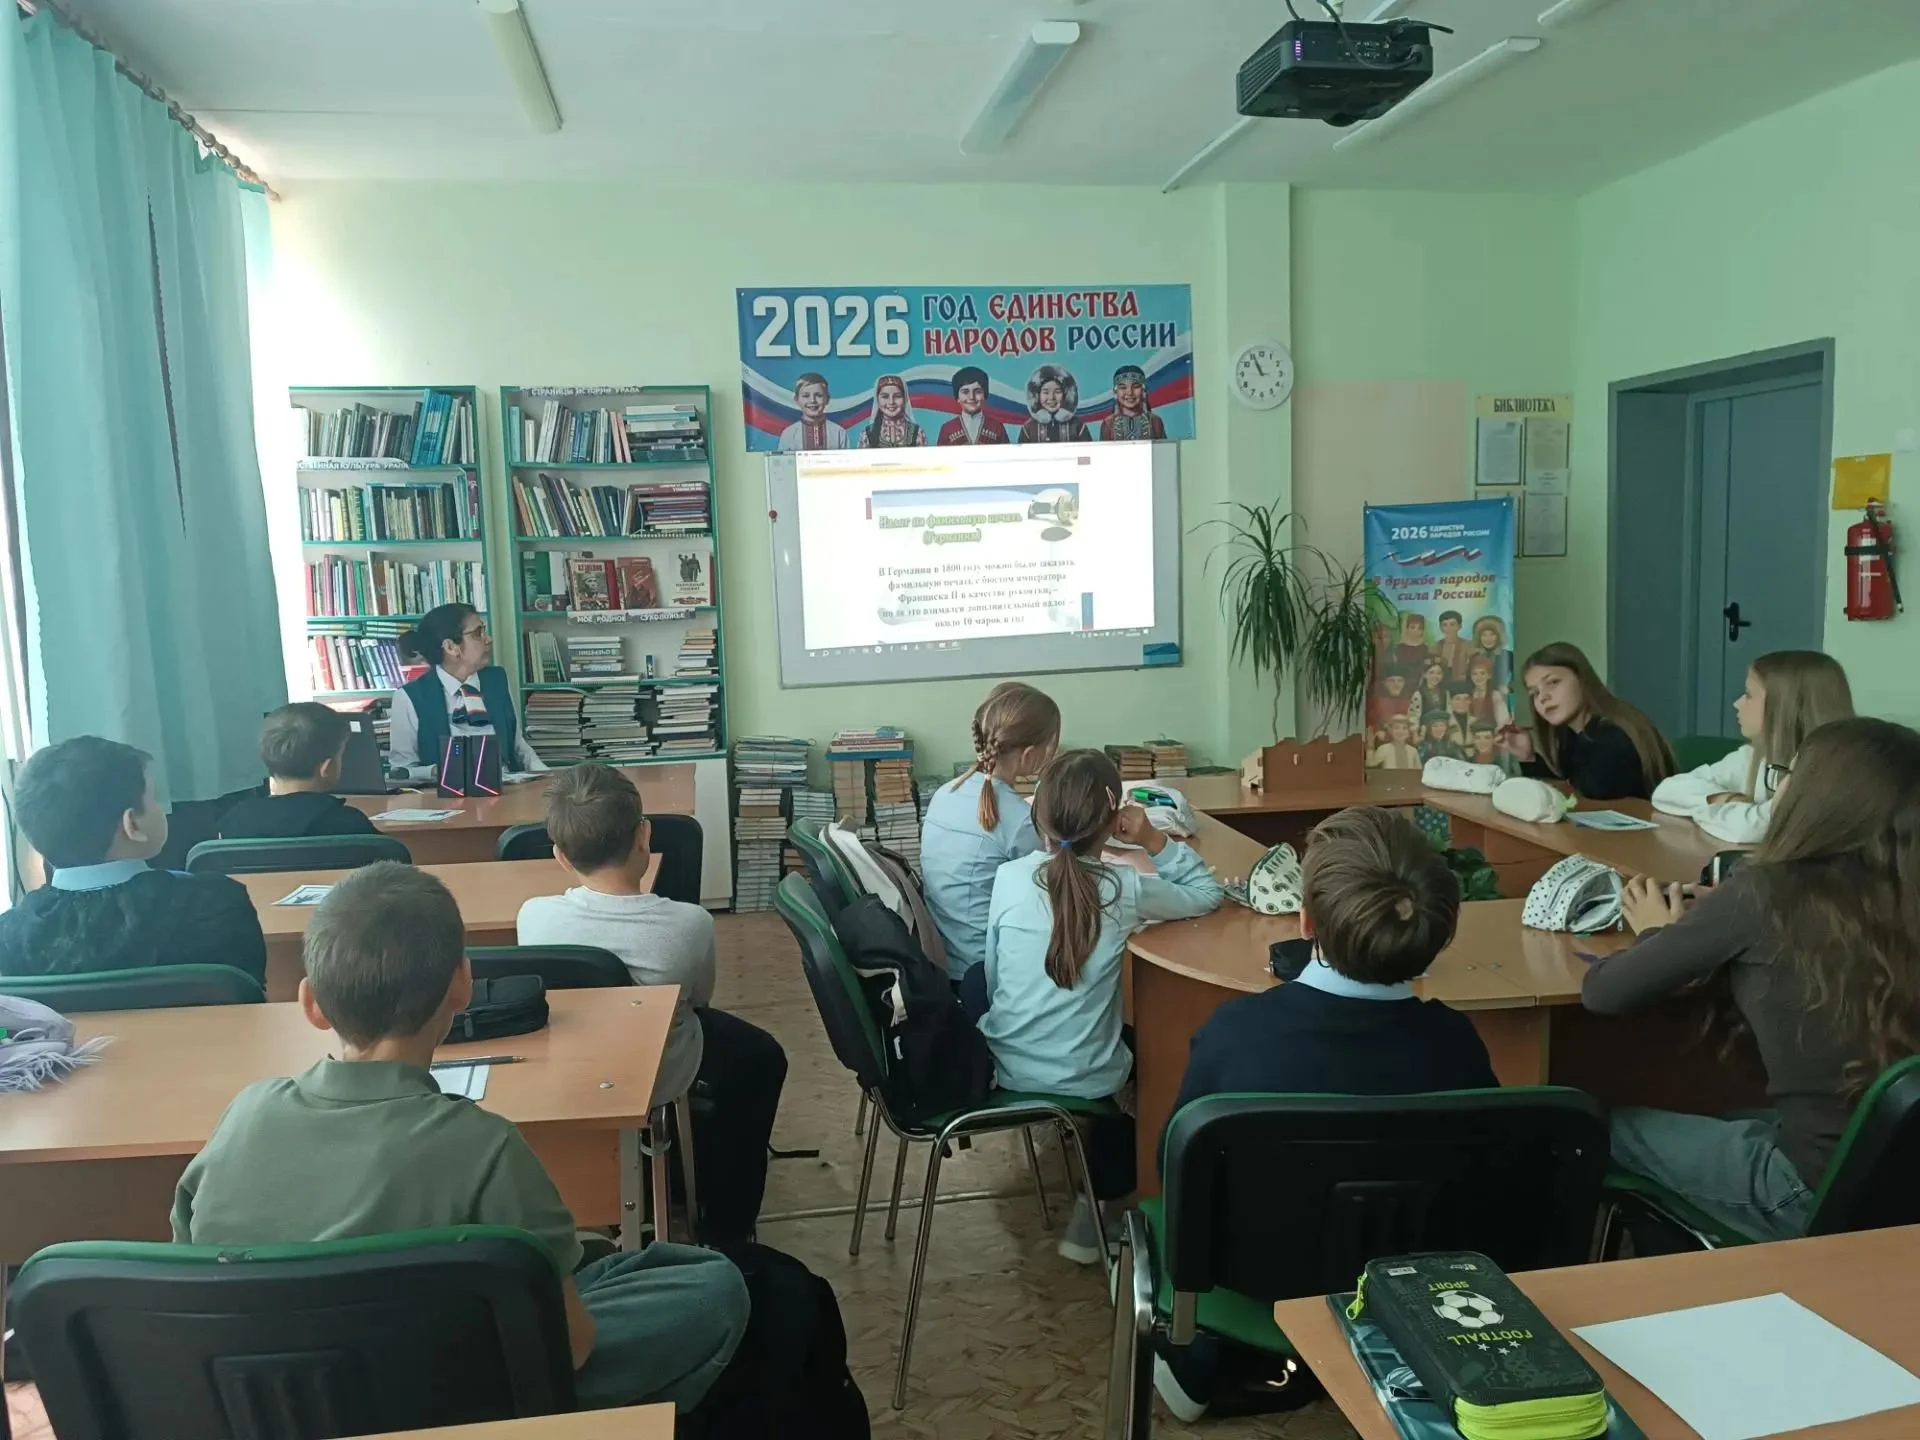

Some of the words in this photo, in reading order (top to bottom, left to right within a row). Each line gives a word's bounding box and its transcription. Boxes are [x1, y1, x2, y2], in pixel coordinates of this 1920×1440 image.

[923, 294, 978, 324] ГОД
[752, 295, 910, 356] 2026
[924, 327, 1056, 357] НАРОДОВ
[1067, 322, 1177, 350] РОССИИ
[1494, 398, 1556, 413] БИБЛИОТЕКА
[1392, 526, 1428, 540] 2026
[1385, 574, 1435, 588] дружбе
[1440, 572, 1496, 585] народов
[1398, 591, 1428, 600] сила
[1433, 587, 1487, 600] России!
[1428, 1281, 1470, 1291] SPORT
[1447, 1330, 1534, 1345] FOOTBALL
